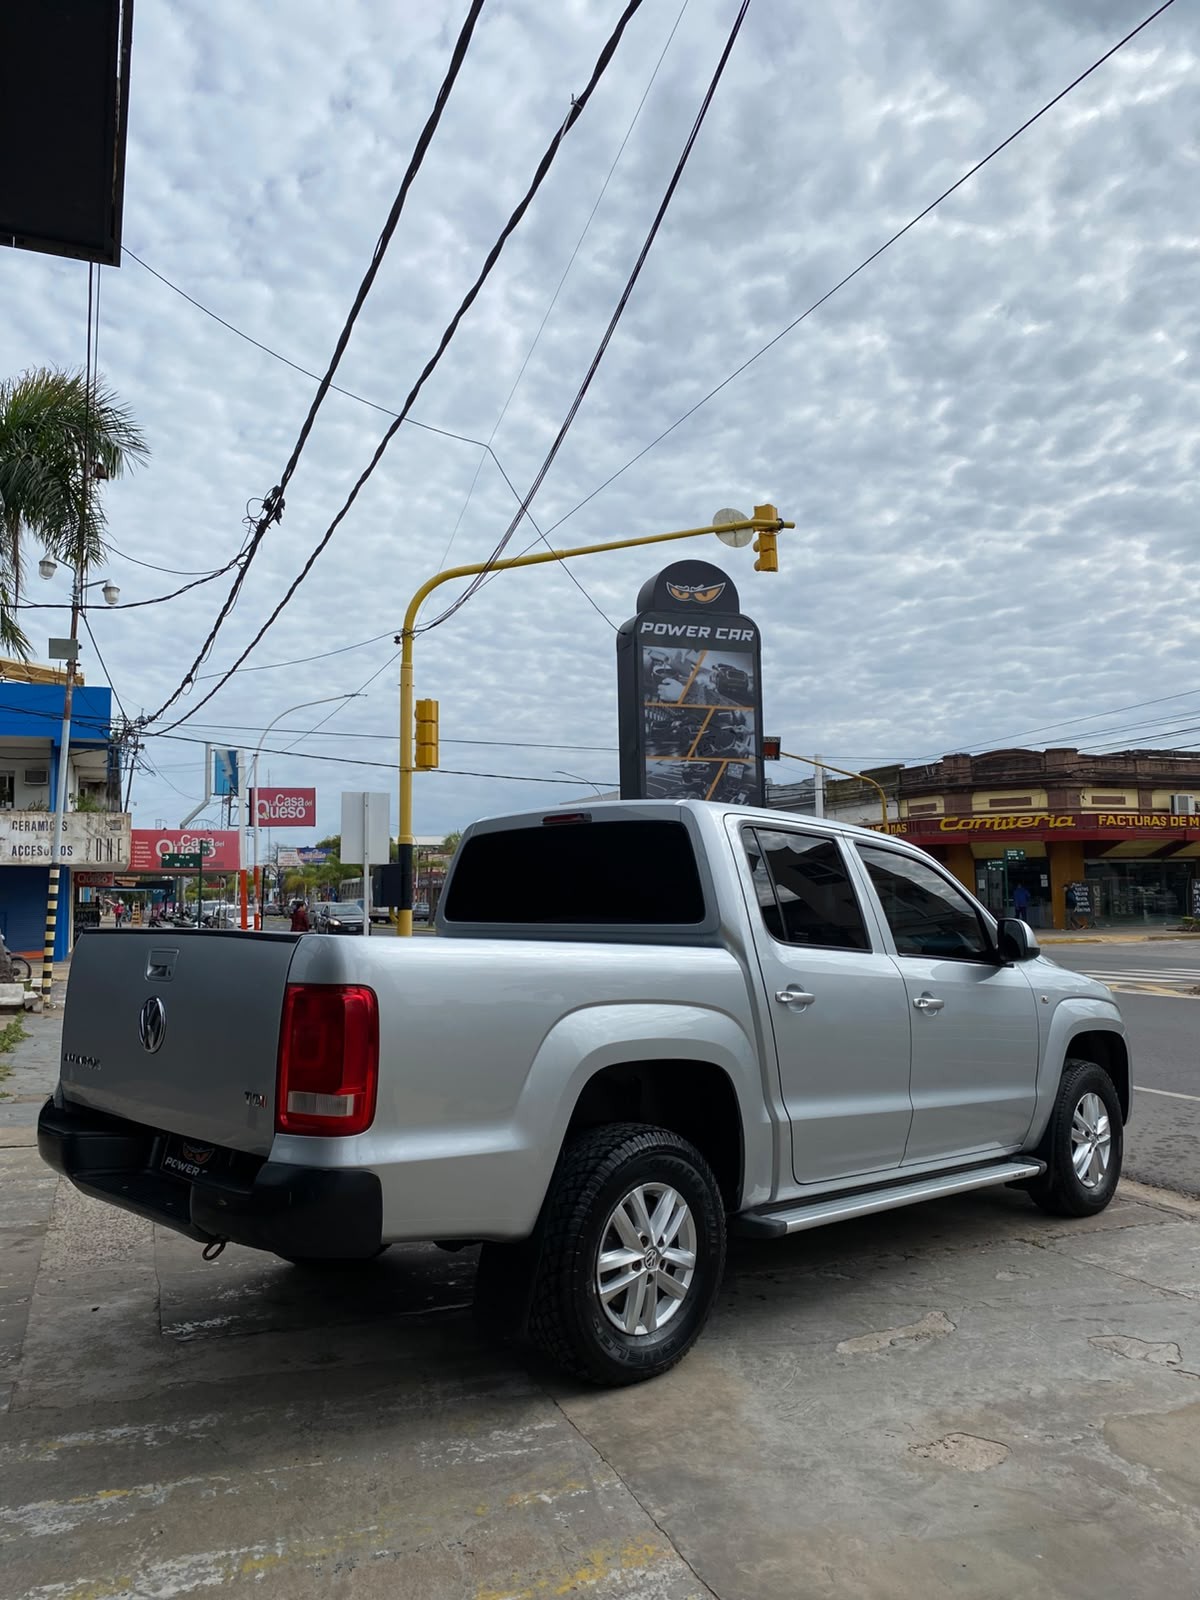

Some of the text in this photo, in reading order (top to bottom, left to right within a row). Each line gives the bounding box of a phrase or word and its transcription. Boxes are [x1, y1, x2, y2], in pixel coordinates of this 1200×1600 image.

[640, 622, 754, 641] POWER CAR
[275, 794, 304, 807] Casa
[257, 799, 306, 819] Queso
[12, 820, 68, 832] CERAMICS
[1098, 815, 1168, 827] FACTURAS
[1170, 816, 1187, 827] DE
